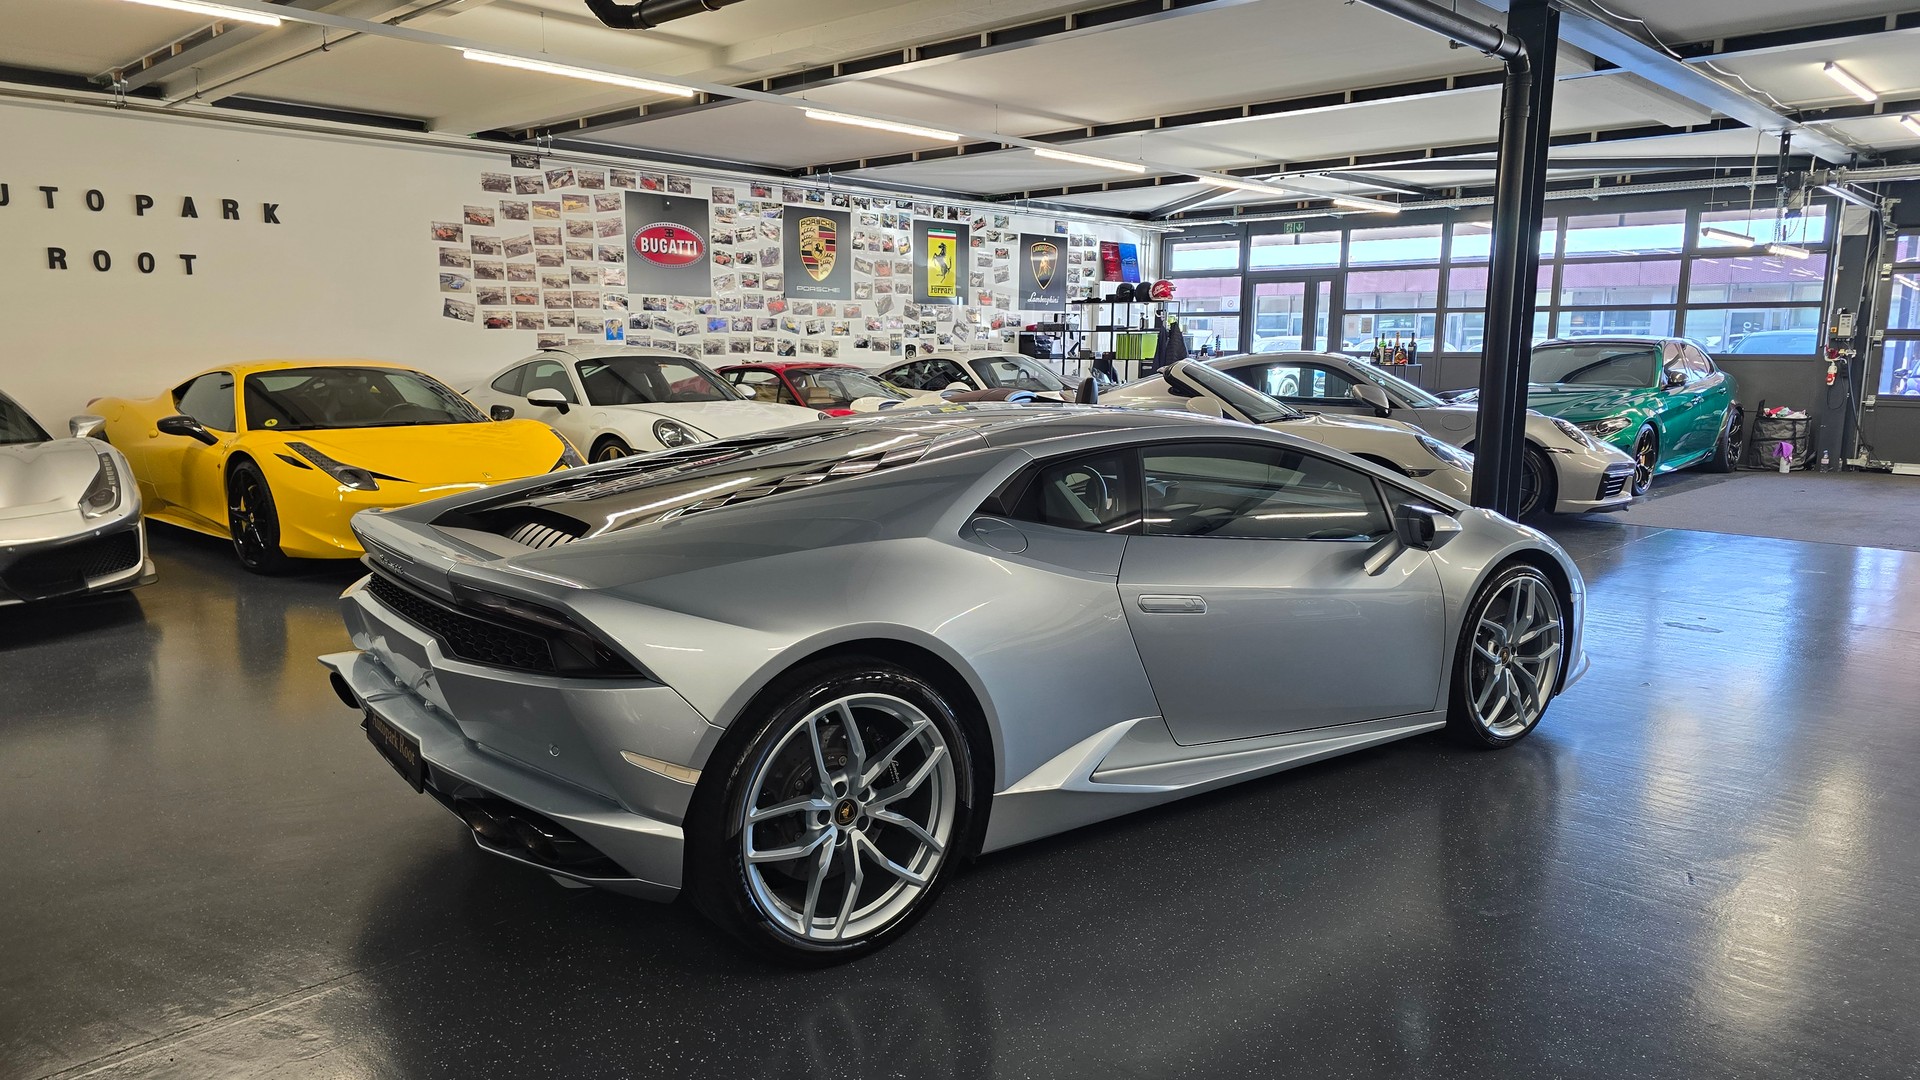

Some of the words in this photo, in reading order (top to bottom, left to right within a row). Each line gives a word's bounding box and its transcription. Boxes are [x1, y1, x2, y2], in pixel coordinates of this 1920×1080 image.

[640, 236, 698, 256] BUGATTI
[47, 247, 197, 275] ROOT
[796, 285, 841, 293] PORSCHE
[930, 285, 954, 295] Ferrari
[1027, 291, 1060, 306] Lamborghini
[371, 713, 399, 751] Autopark
[399, 735, 416, 767] Root
